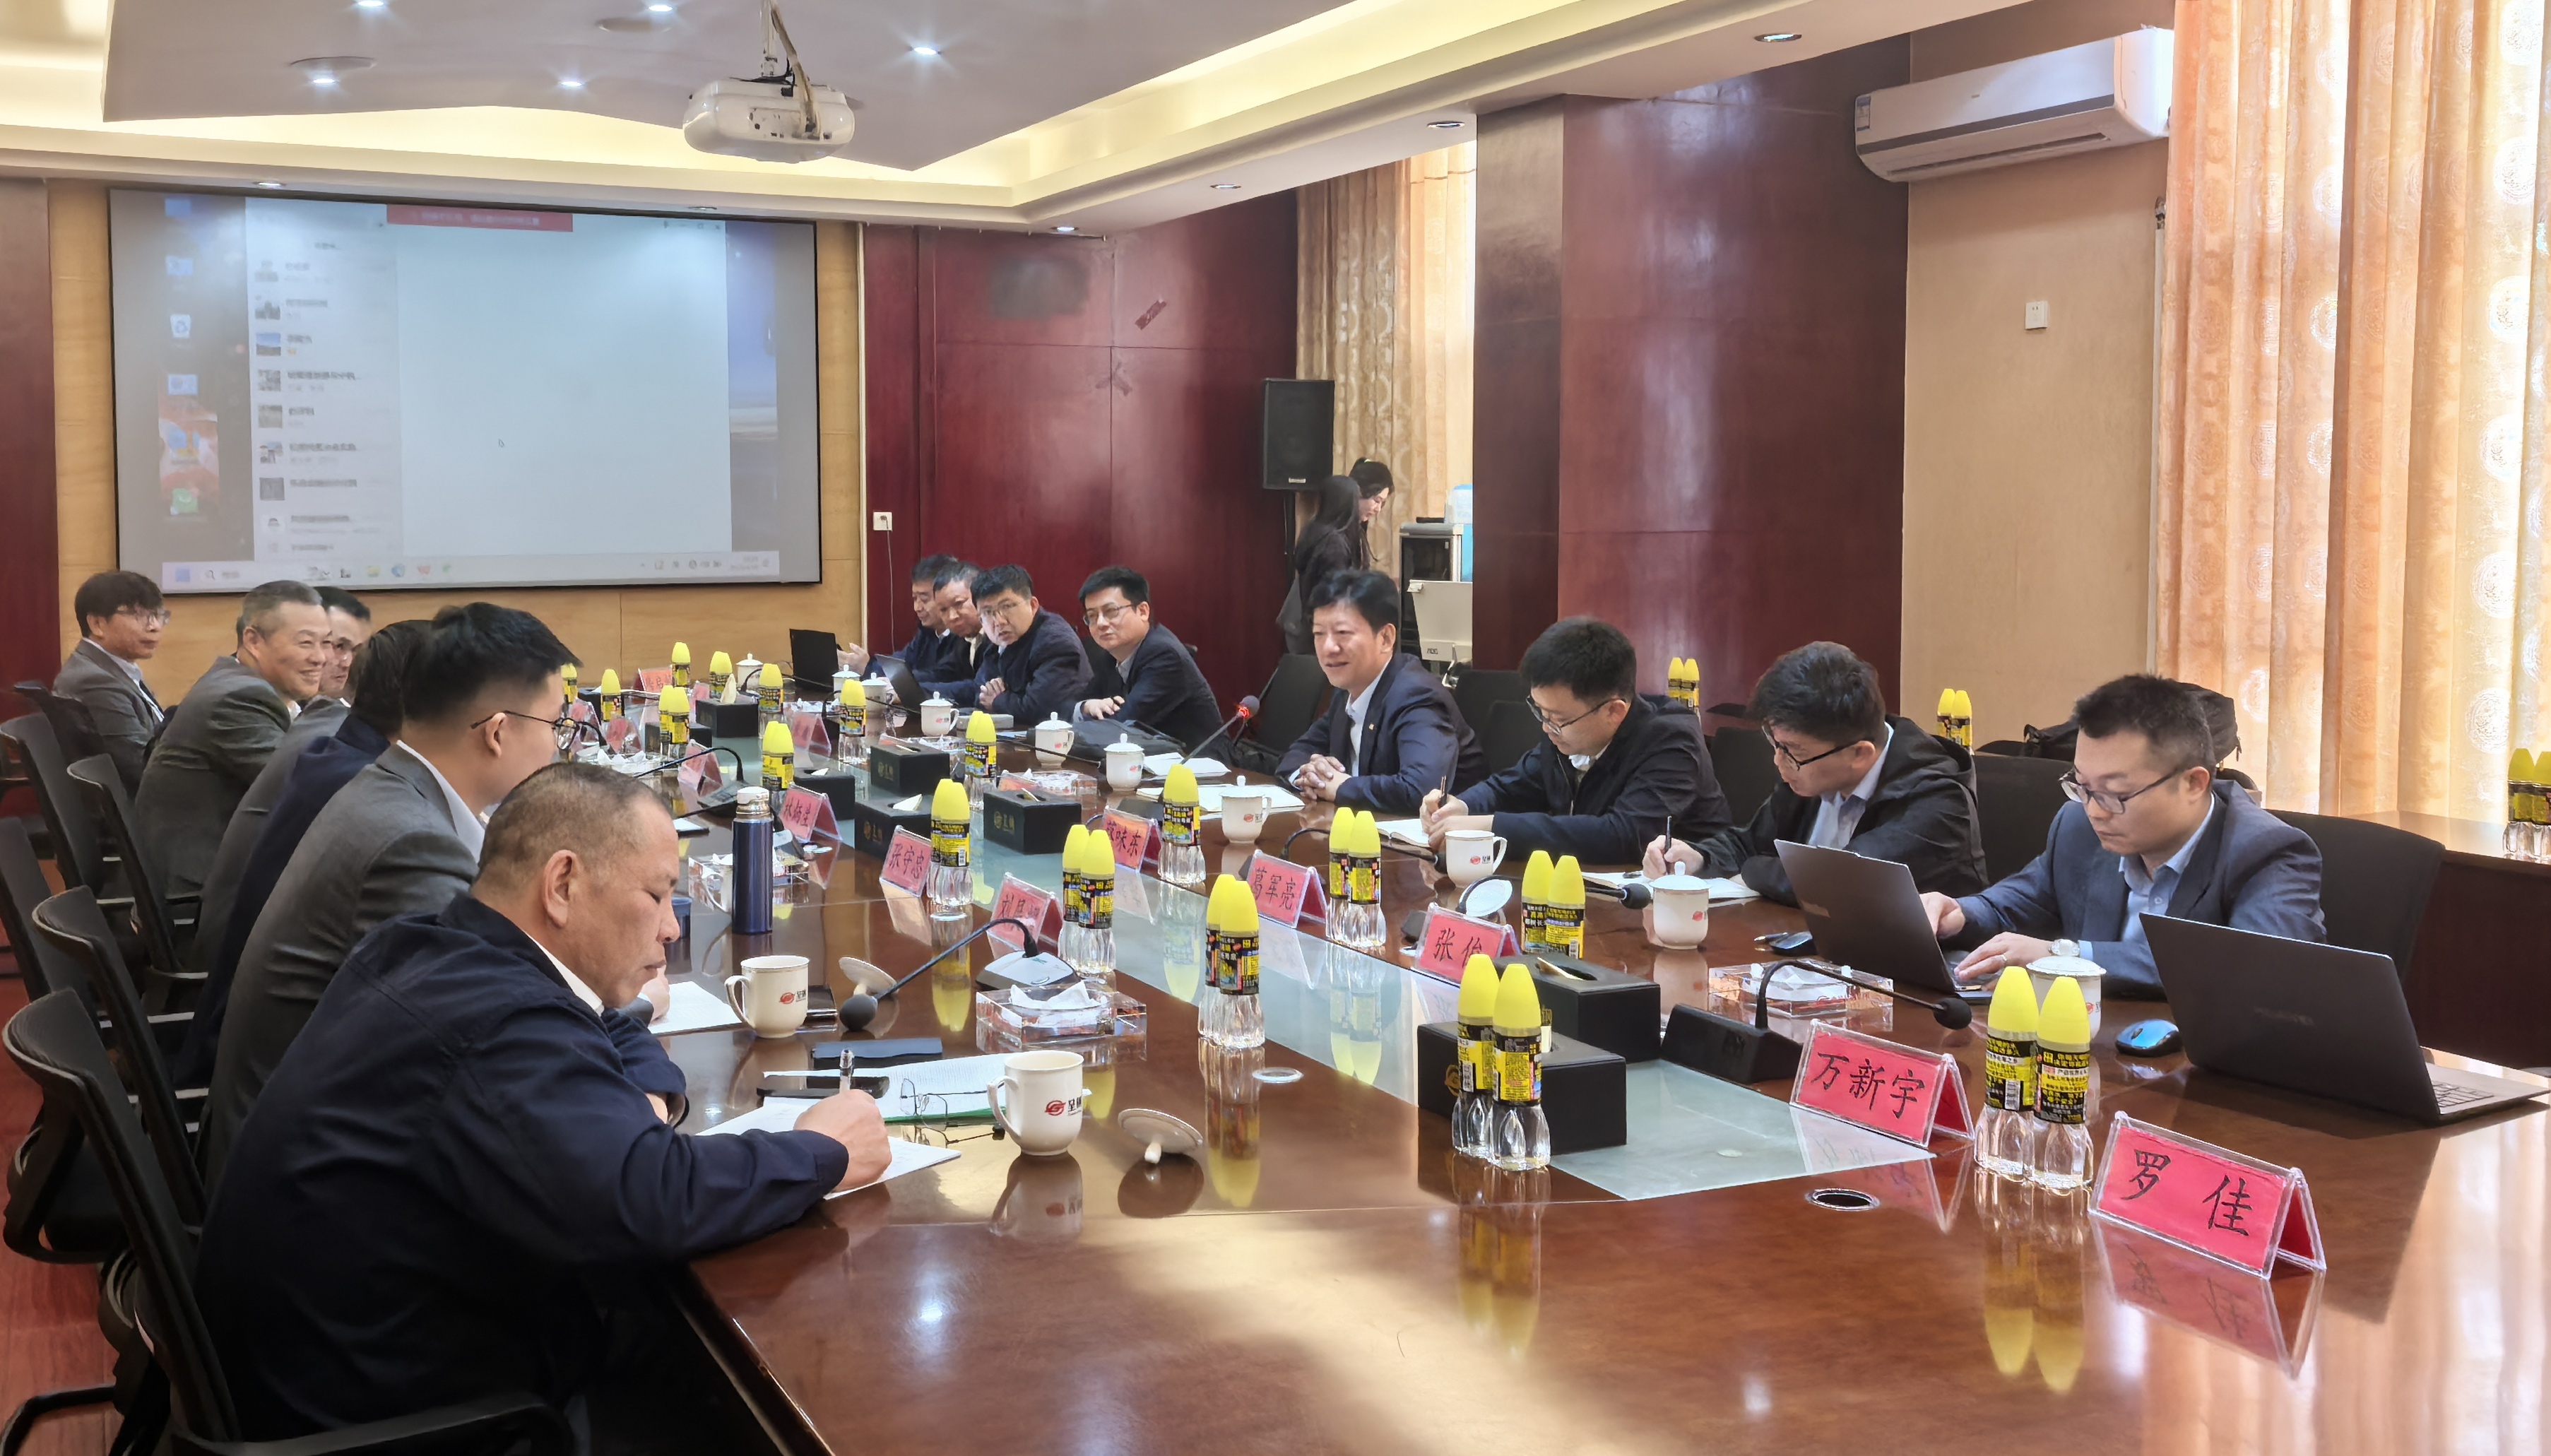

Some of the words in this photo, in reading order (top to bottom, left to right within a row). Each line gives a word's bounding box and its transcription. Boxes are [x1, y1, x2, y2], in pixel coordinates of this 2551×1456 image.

[1253, 866, 1296, 910] 葛军亮
[1810, 1052, 1925, 1119] 万新宇
[2120, 1149, 2253, 1236] 罗佳
